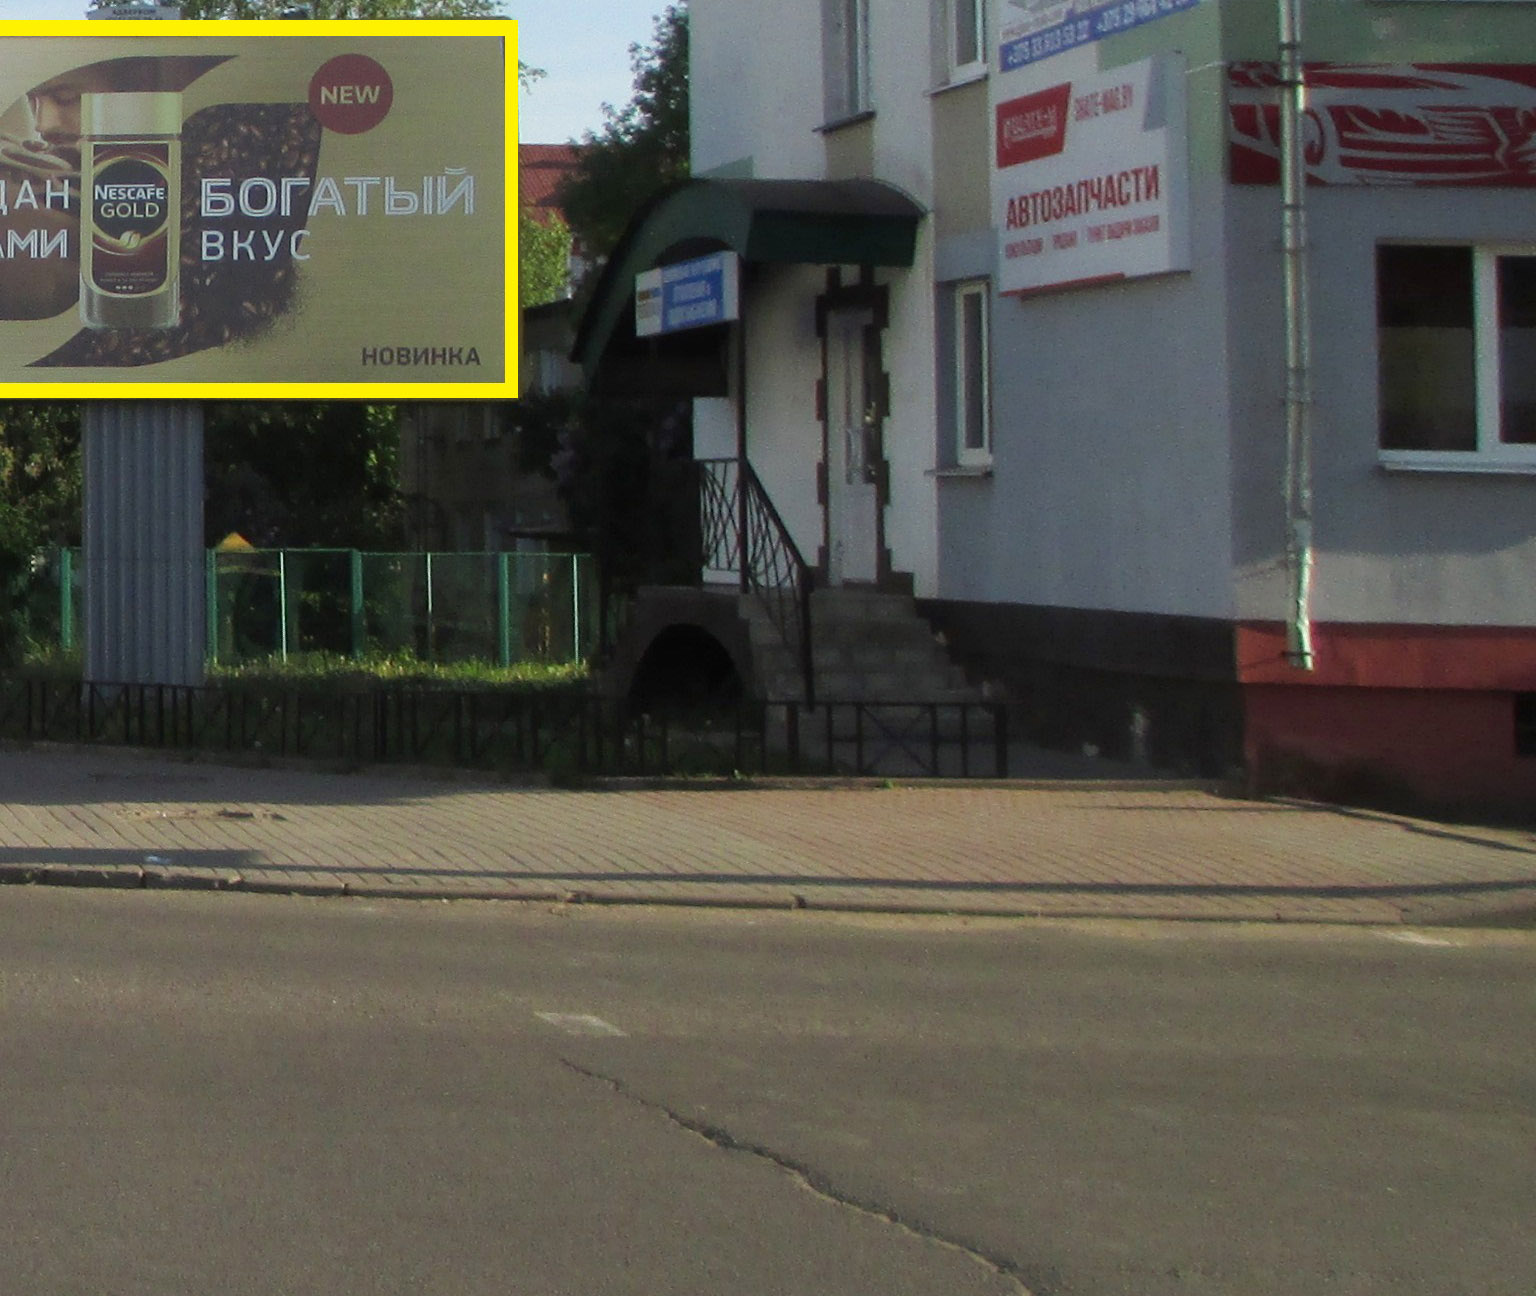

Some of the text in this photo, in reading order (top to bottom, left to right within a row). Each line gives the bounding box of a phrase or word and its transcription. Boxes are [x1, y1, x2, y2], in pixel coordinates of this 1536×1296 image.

[320, 85, 381, 106] NEW
[200, 166, 476, 217] БОГАТЫЙ
[1006, 165, 1160, 230] АВТОЗАПЧАСТИ
[100, 202, 160, 218] GOLD
[200, 229, 312, 262] ВКУС
[362, 346, 480, 367] НОВИНКА
